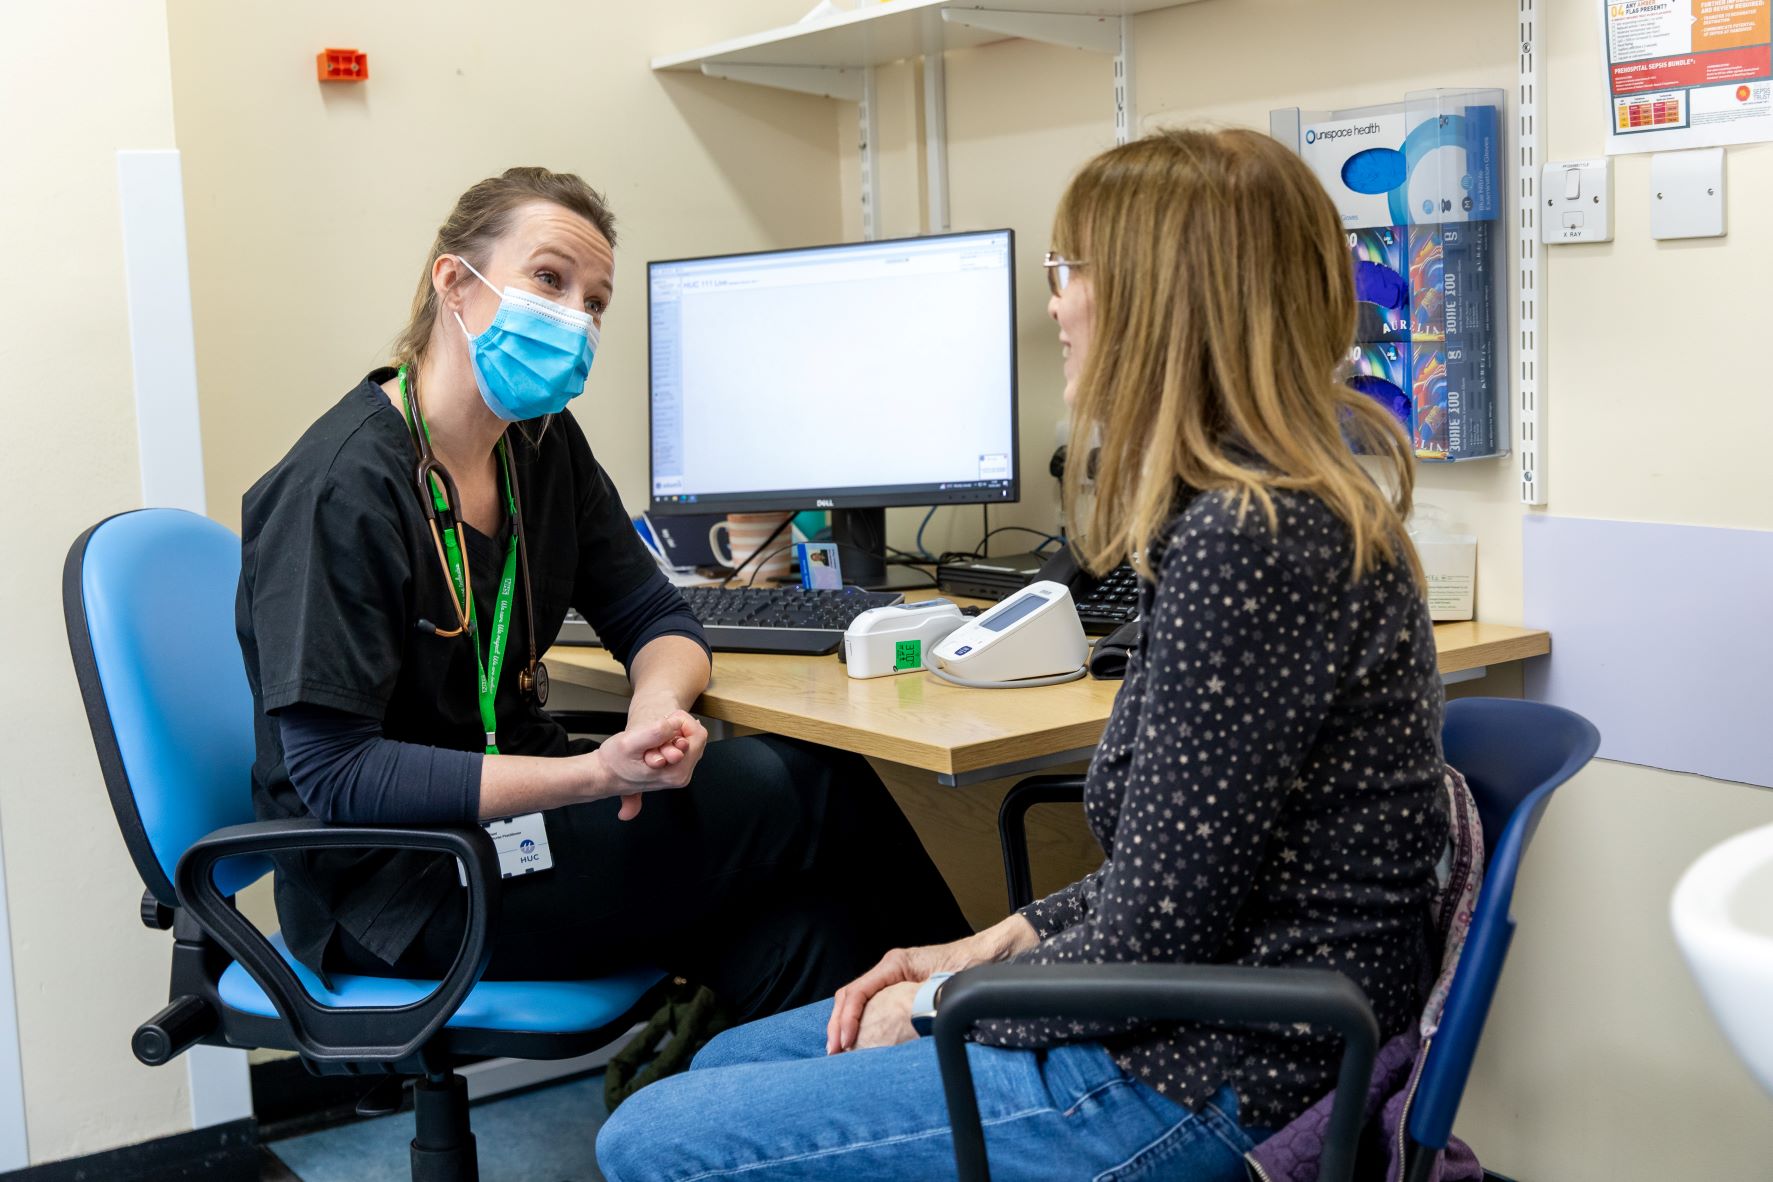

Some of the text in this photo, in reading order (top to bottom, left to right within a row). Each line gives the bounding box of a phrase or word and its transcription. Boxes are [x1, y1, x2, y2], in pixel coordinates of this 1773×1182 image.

[1611, 6, 1624, 17] 04
[1640, 4, 1668, 13] PRESENT?
[1614, 65, 1648, 74] PREHOSPITAL
[1316, 122, 1381, 142] unispace health
[520, 854, 539, 863] HUC
